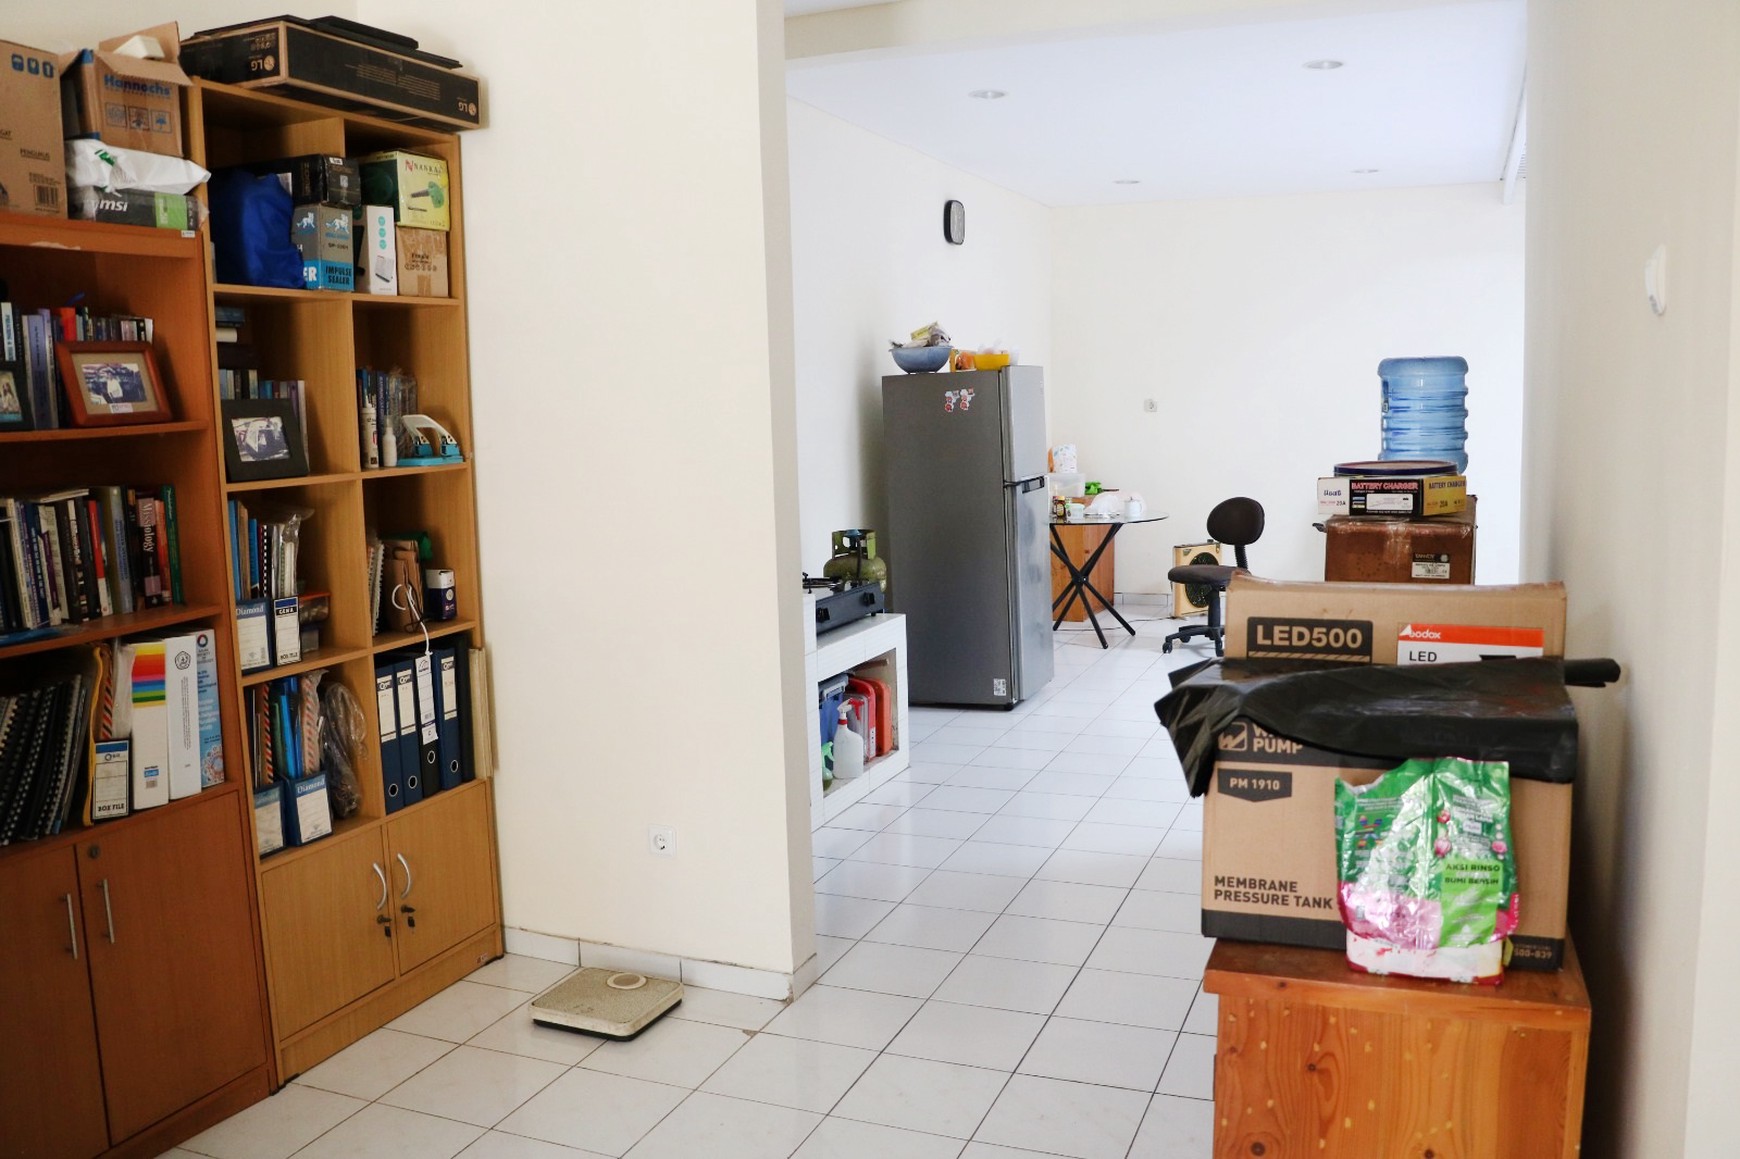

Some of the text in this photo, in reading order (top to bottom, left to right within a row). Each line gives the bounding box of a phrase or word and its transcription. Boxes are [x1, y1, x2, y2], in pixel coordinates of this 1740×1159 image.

[251, 59, 263, 71] LG
[458, 102, 468, 113] LG
[100, 199, 128, 212] msi
[326, 266, 351, 277] IMPULSE
[328, 275, 350, 285] SEALER
[1351, 482, 1419, 490] BATTERY CHARGER
[142, 502, 156, 553] Missiology
[1256, 624, 1363, 649] LED500
[1409, 650, 1437, 662] LED
[1253, 737, 1304, 754] PUMP
[1229, 777, 1280, 791] PM 1910
[1470, 863, 1500, 872] RINSO
[1214, 875, 1298, 893] MEMBRANE
[1214, 889, 1334, 910] PRESSURE TANK
